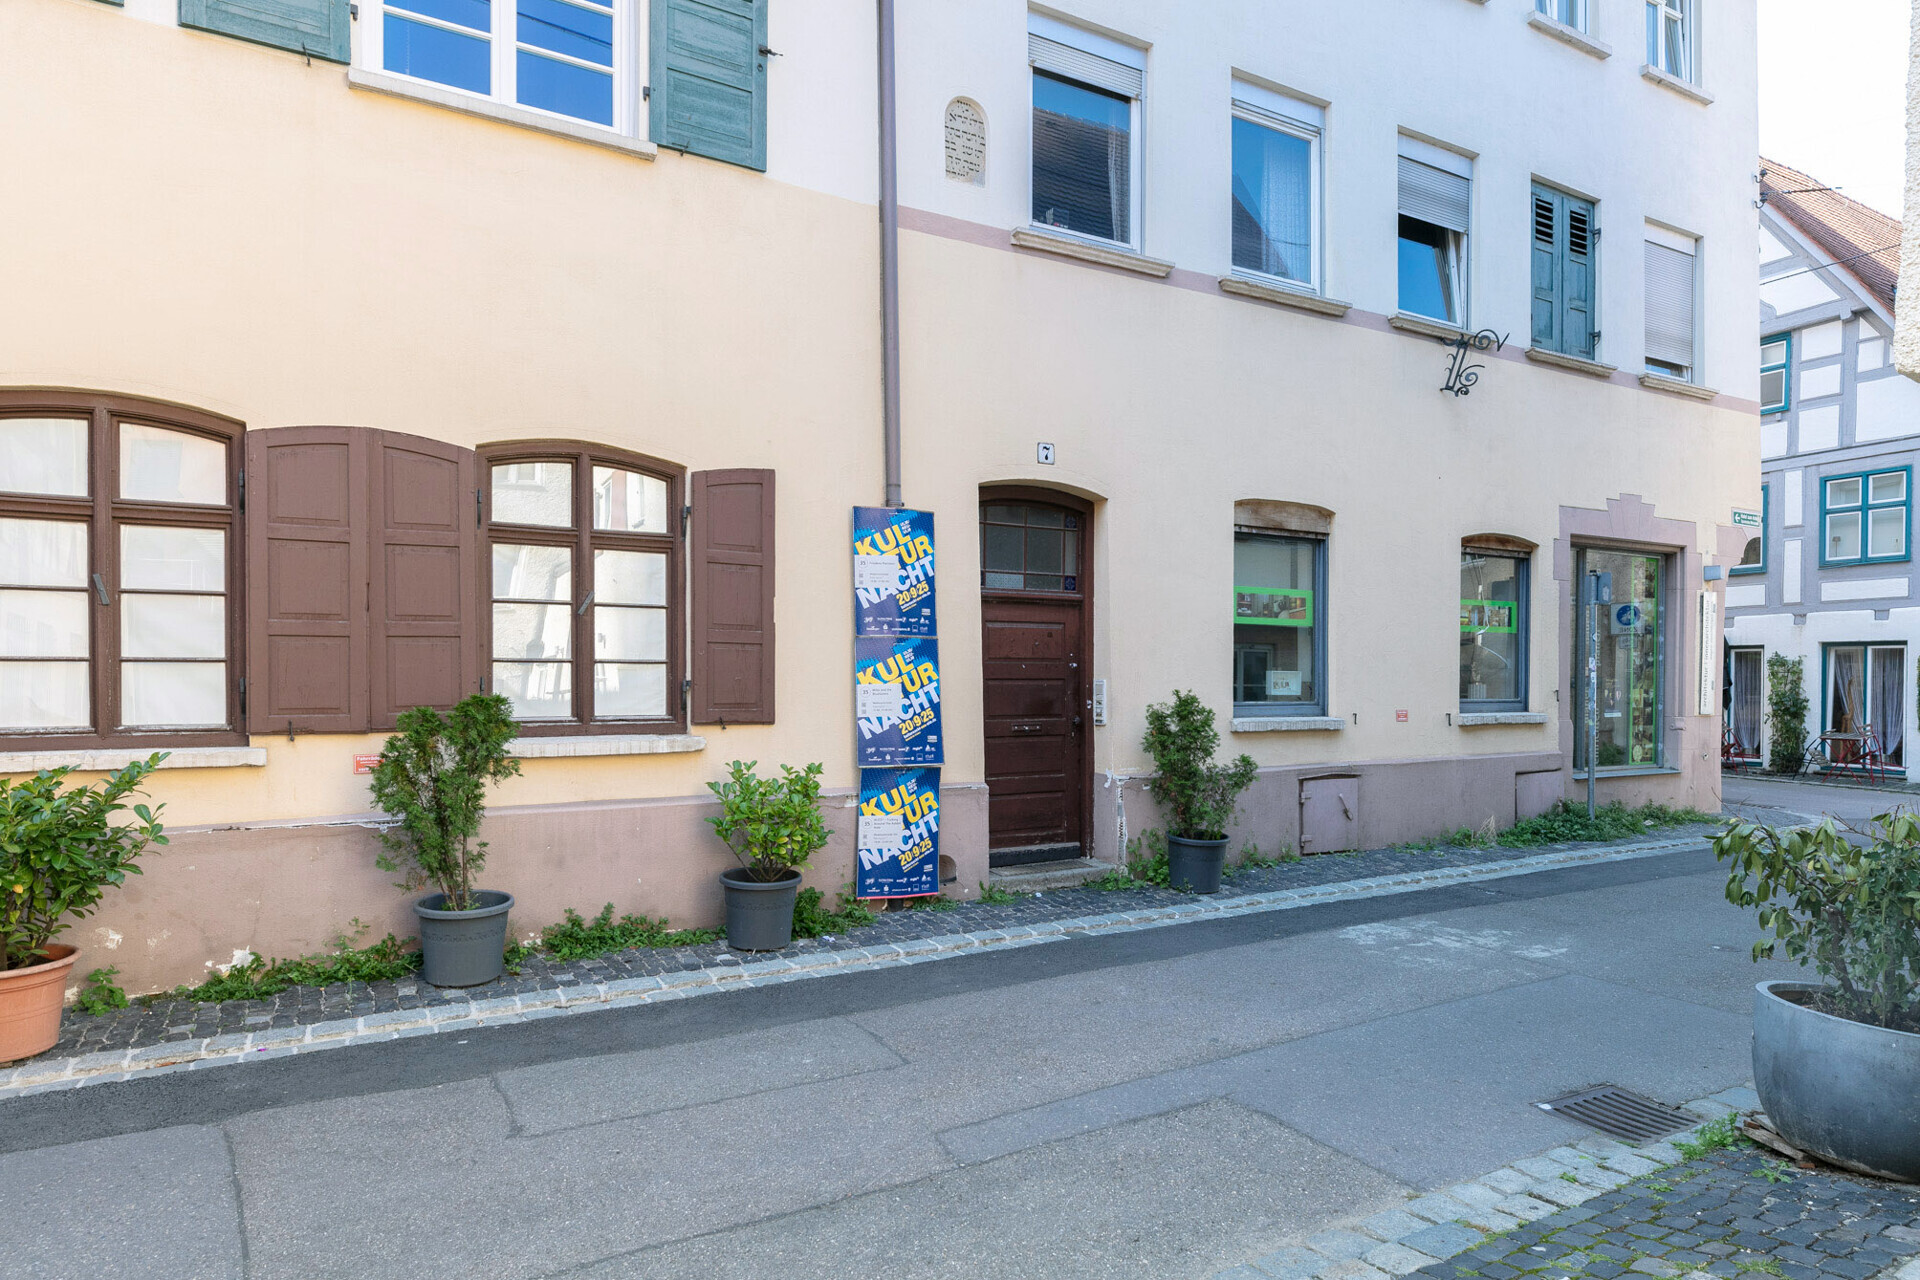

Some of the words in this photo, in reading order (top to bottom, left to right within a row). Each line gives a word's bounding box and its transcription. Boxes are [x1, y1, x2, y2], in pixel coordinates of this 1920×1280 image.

[1042, 446, 1050, 461] 7
[855, 524, 911, 556] KUL
[856, 555, 935, 610] NACHT
[856, 653, 914, 684] KUL
[857, 681, 940, 740] NACHT
[860, 784, 916, 816] KUL
[859, 810, 939, 871] NACHT
